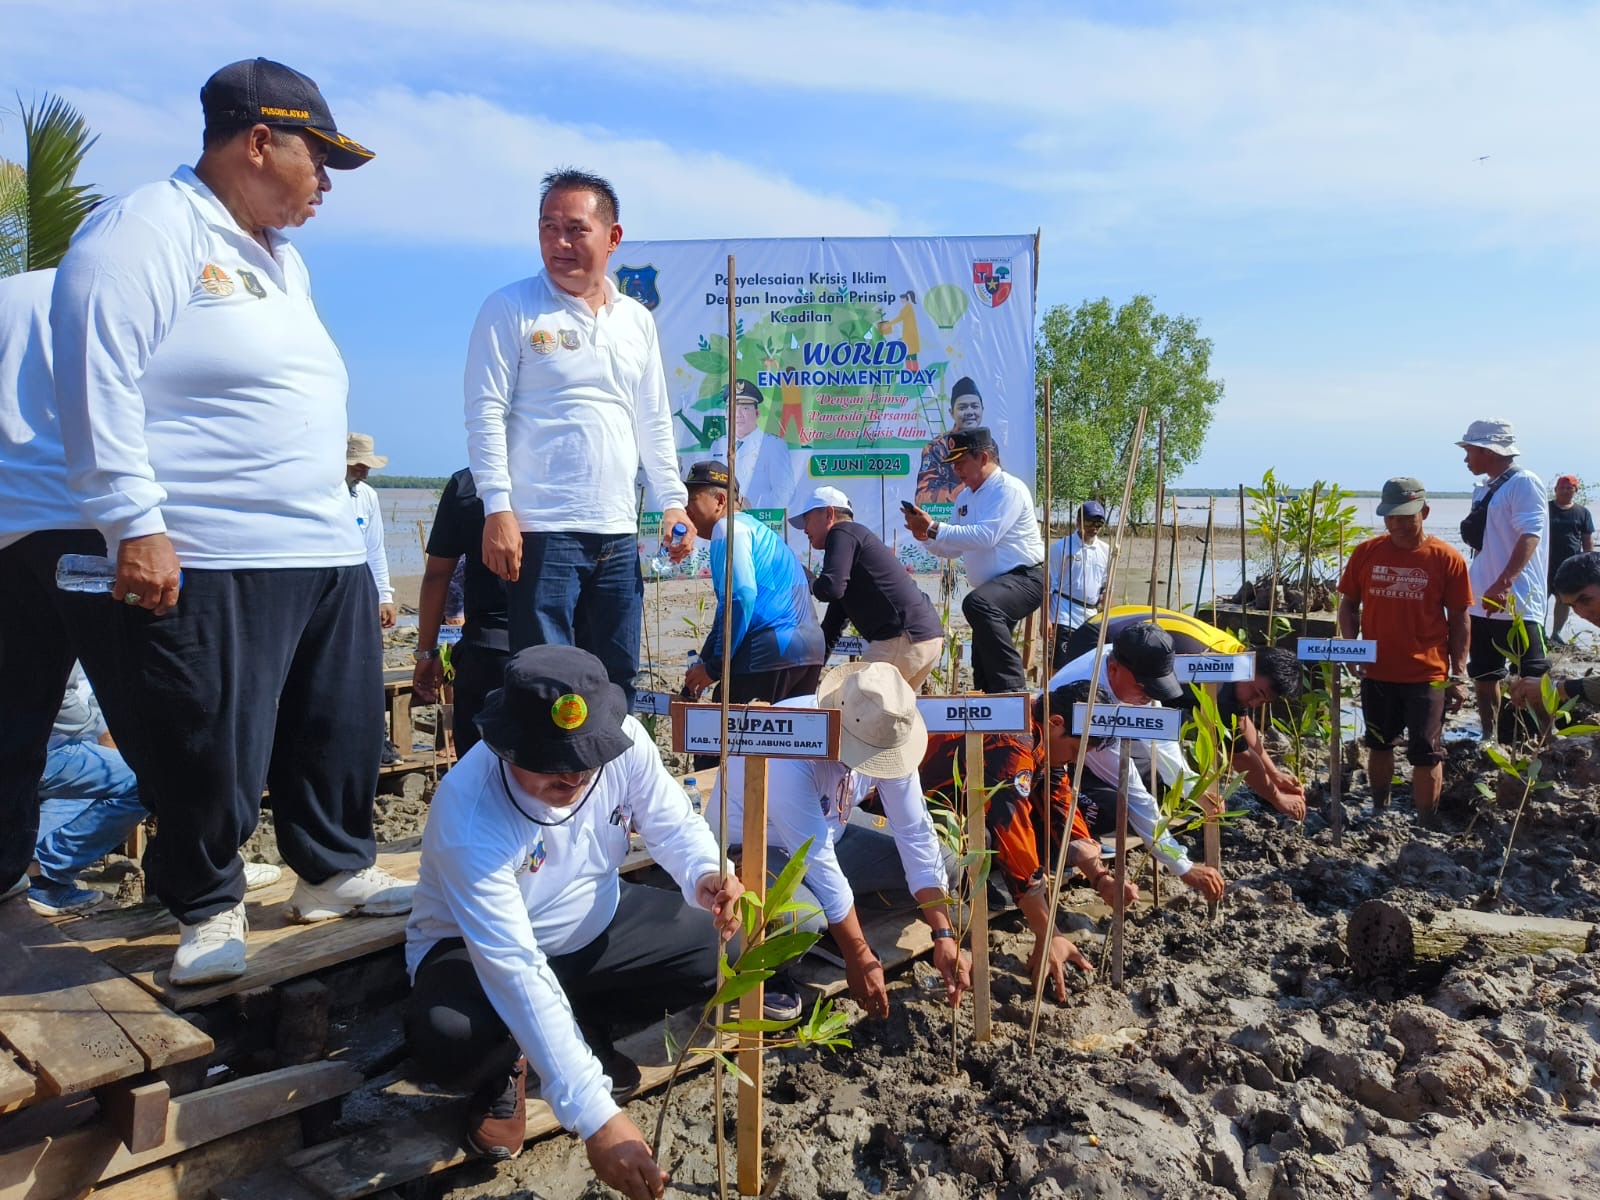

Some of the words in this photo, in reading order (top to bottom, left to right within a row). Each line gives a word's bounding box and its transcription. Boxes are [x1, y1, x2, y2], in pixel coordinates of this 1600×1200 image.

[809, 271, 848, 285] Krisis
[852, 271, 887, 284] Iklim
[765, 291, 814, 304] Inovasi
[818, 291, 844, 304] dan
[849, 291, 896, 305] Prinsip
[771, 311, 832, 323] Keadilan
[802, 341, 908, 366] WORLD
[758, 370, 894, 386] ENVIRONMENT
[901, 369, 937, 384] DAY
[866, 409, 918, 421] Bersama
[819, 459, 827, 471] 5
[831, 459, 863, 471] JUNI
[868, 458, 901, 471] 2024
[758, 511, 771, 519] SH
[1307, 645, 1366, 655] KEJAKSAAN
[1188, 662, 1234, 672] DANDIM
[946, 706, 992, 719] DPRD
[727, 717, 793, 733] BUPATI
[1090, 715, 1164, 729] KAPOLRES
[690, 736, 711, 744] KAB.
[713, 737, 754, 747] TJUNG
[755, 738, 792, 748] JABUNG
[794, 740, 824, 749] BARAT
